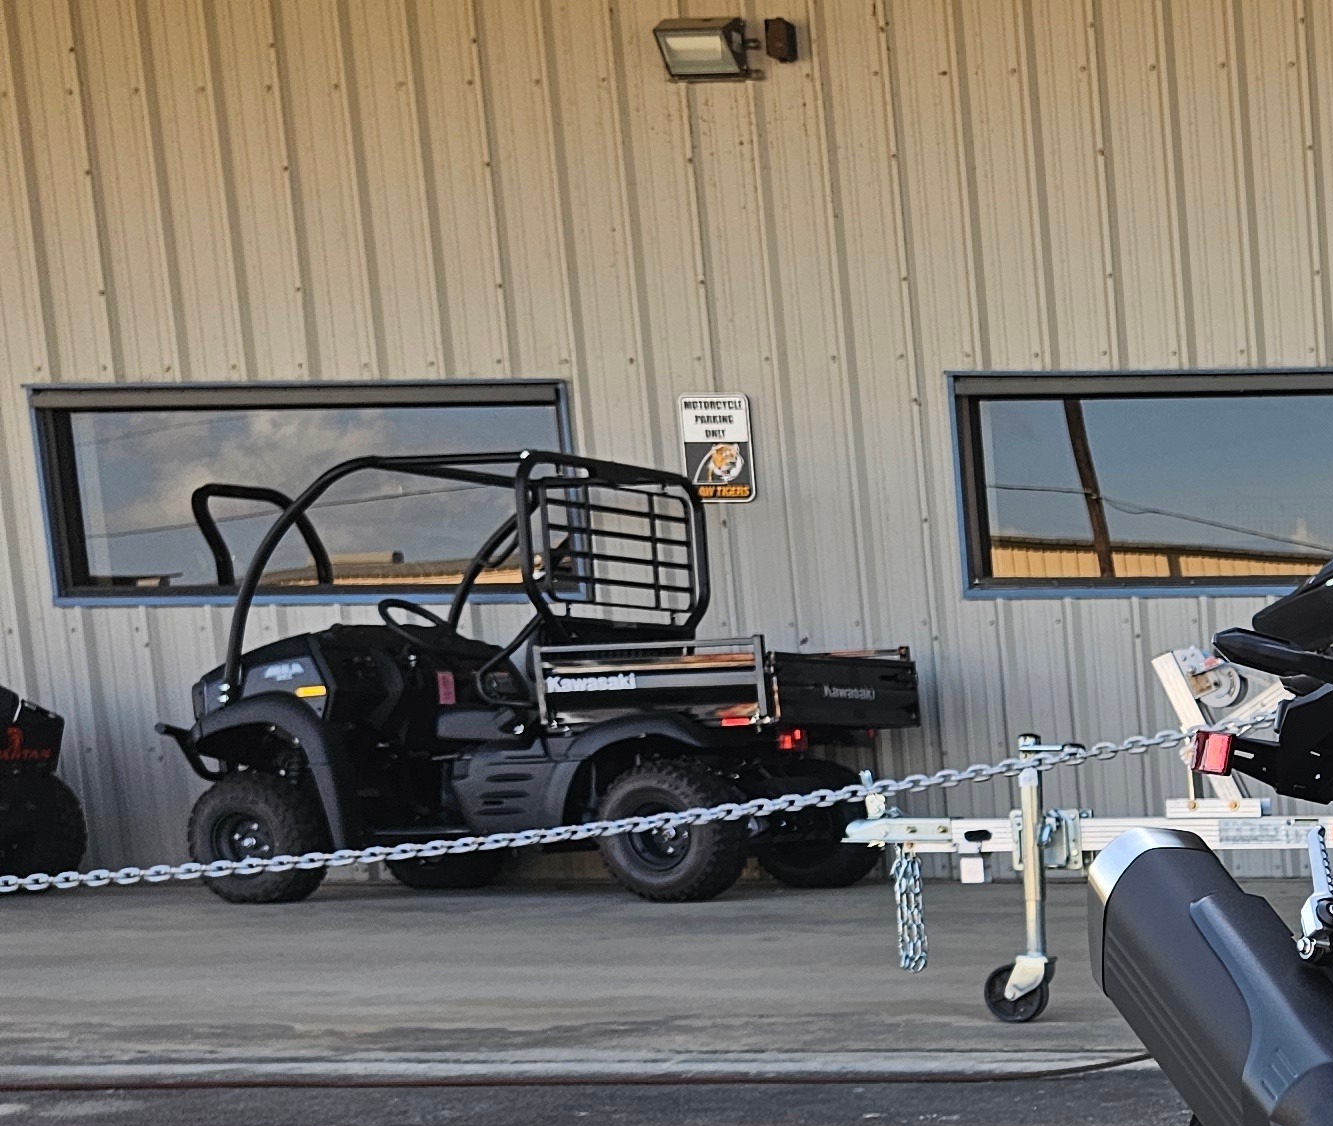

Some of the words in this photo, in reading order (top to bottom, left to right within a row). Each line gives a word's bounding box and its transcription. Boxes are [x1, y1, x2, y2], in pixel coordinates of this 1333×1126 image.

[683, 400, 742, 411] MOTORCYCLE
[694, 415, 734, 425] PARKING
[705, 429, 726, 439] ONLY
[546, 672, 637, 693] Kawasaki
